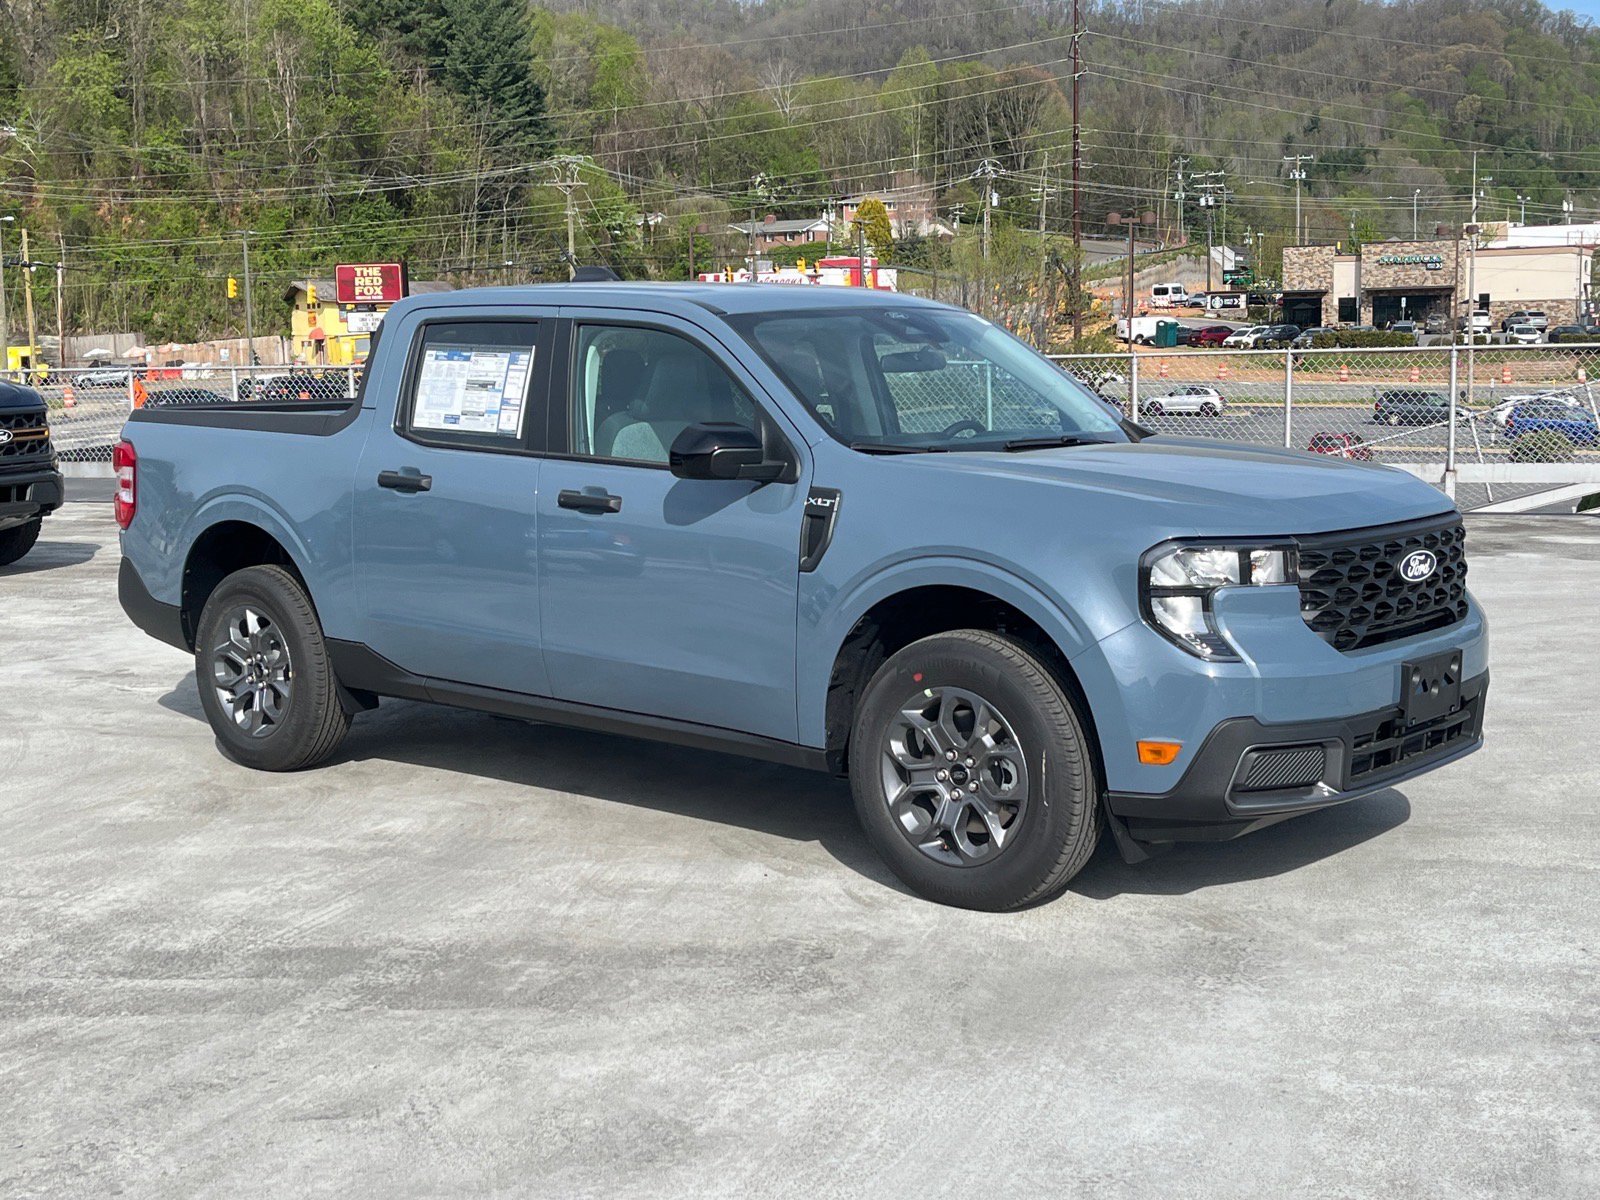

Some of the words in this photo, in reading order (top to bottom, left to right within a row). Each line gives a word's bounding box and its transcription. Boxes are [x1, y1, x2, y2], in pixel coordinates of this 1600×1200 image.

[1379, 255, 1442, 264] STARBUCKS
[354, 267, 382, 277] THE
[354, 277, 383, 286] RED
[355, 286, 384, 296] FOX
[807, 496, 835, 507] XLT
[1407, 554, 1431, 578] Ford
